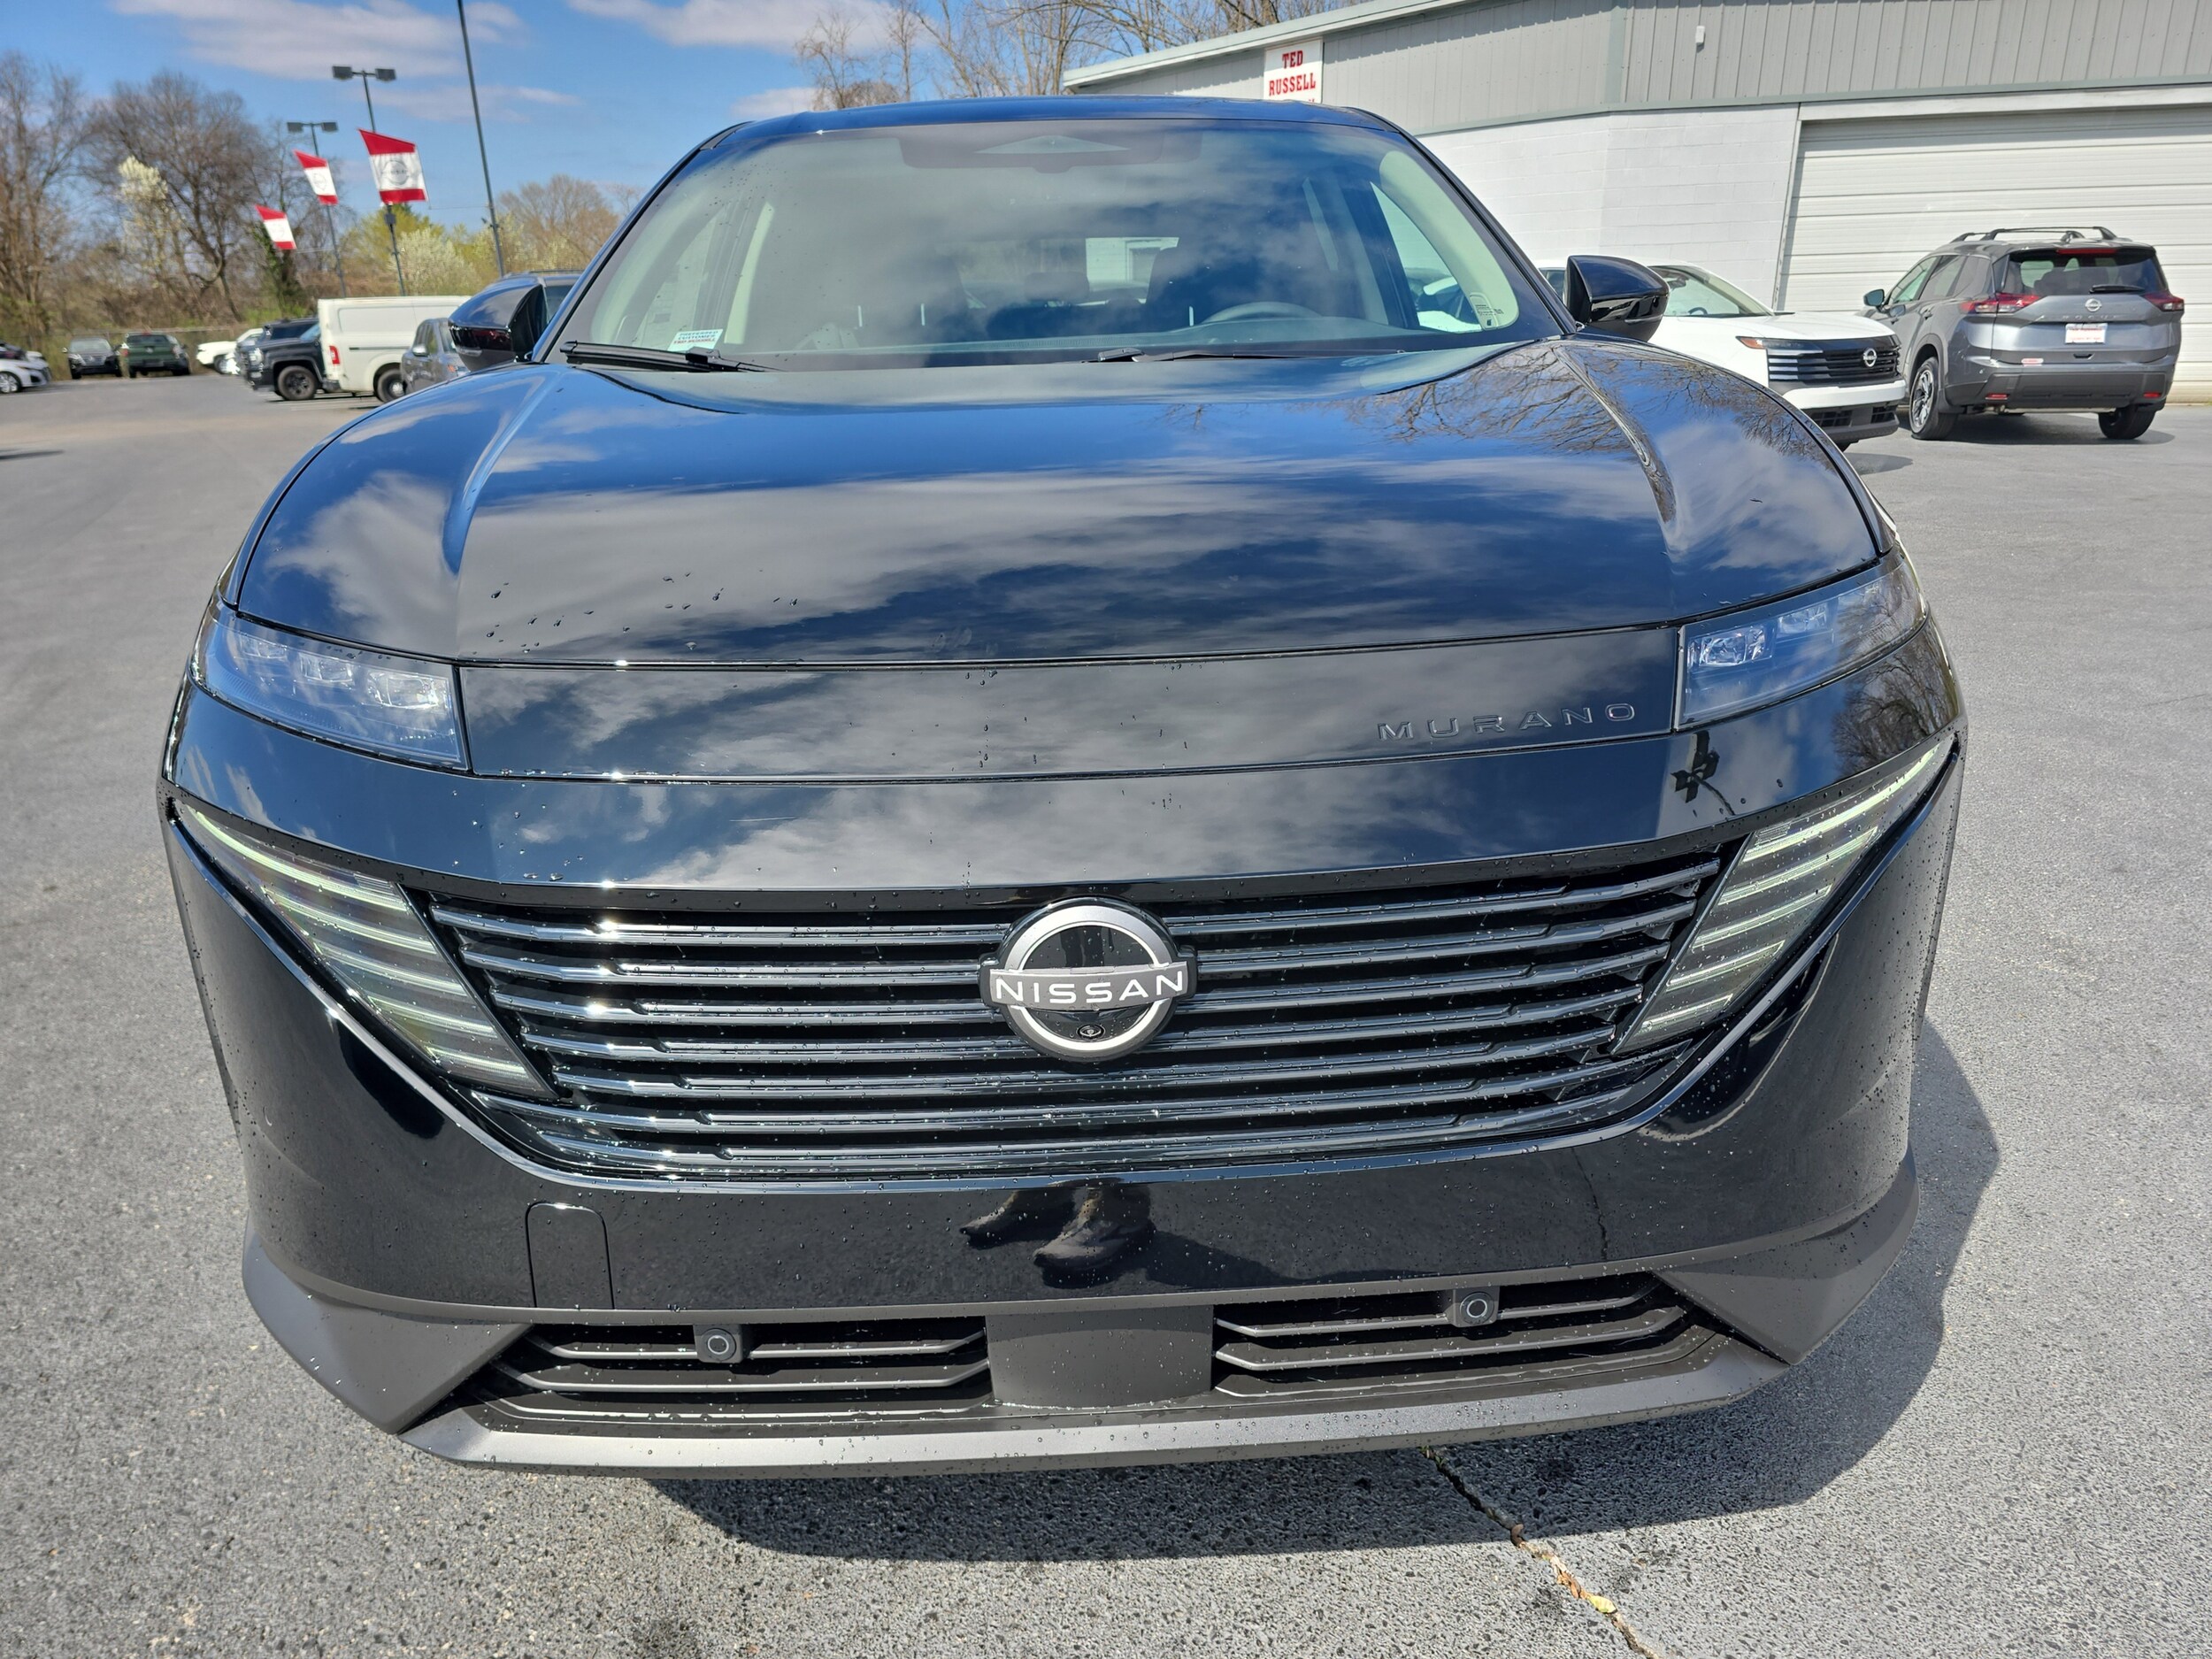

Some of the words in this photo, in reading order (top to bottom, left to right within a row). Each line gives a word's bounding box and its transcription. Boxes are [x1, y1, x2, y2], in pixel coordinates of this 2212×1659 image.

[1282, 50, 1303, 69] TED
[1269, 73, 1316, 96] RUSSELL
[1377, 703, 1636, 741] MURANO
[995, 971, 1183, 1004] NISSAN
